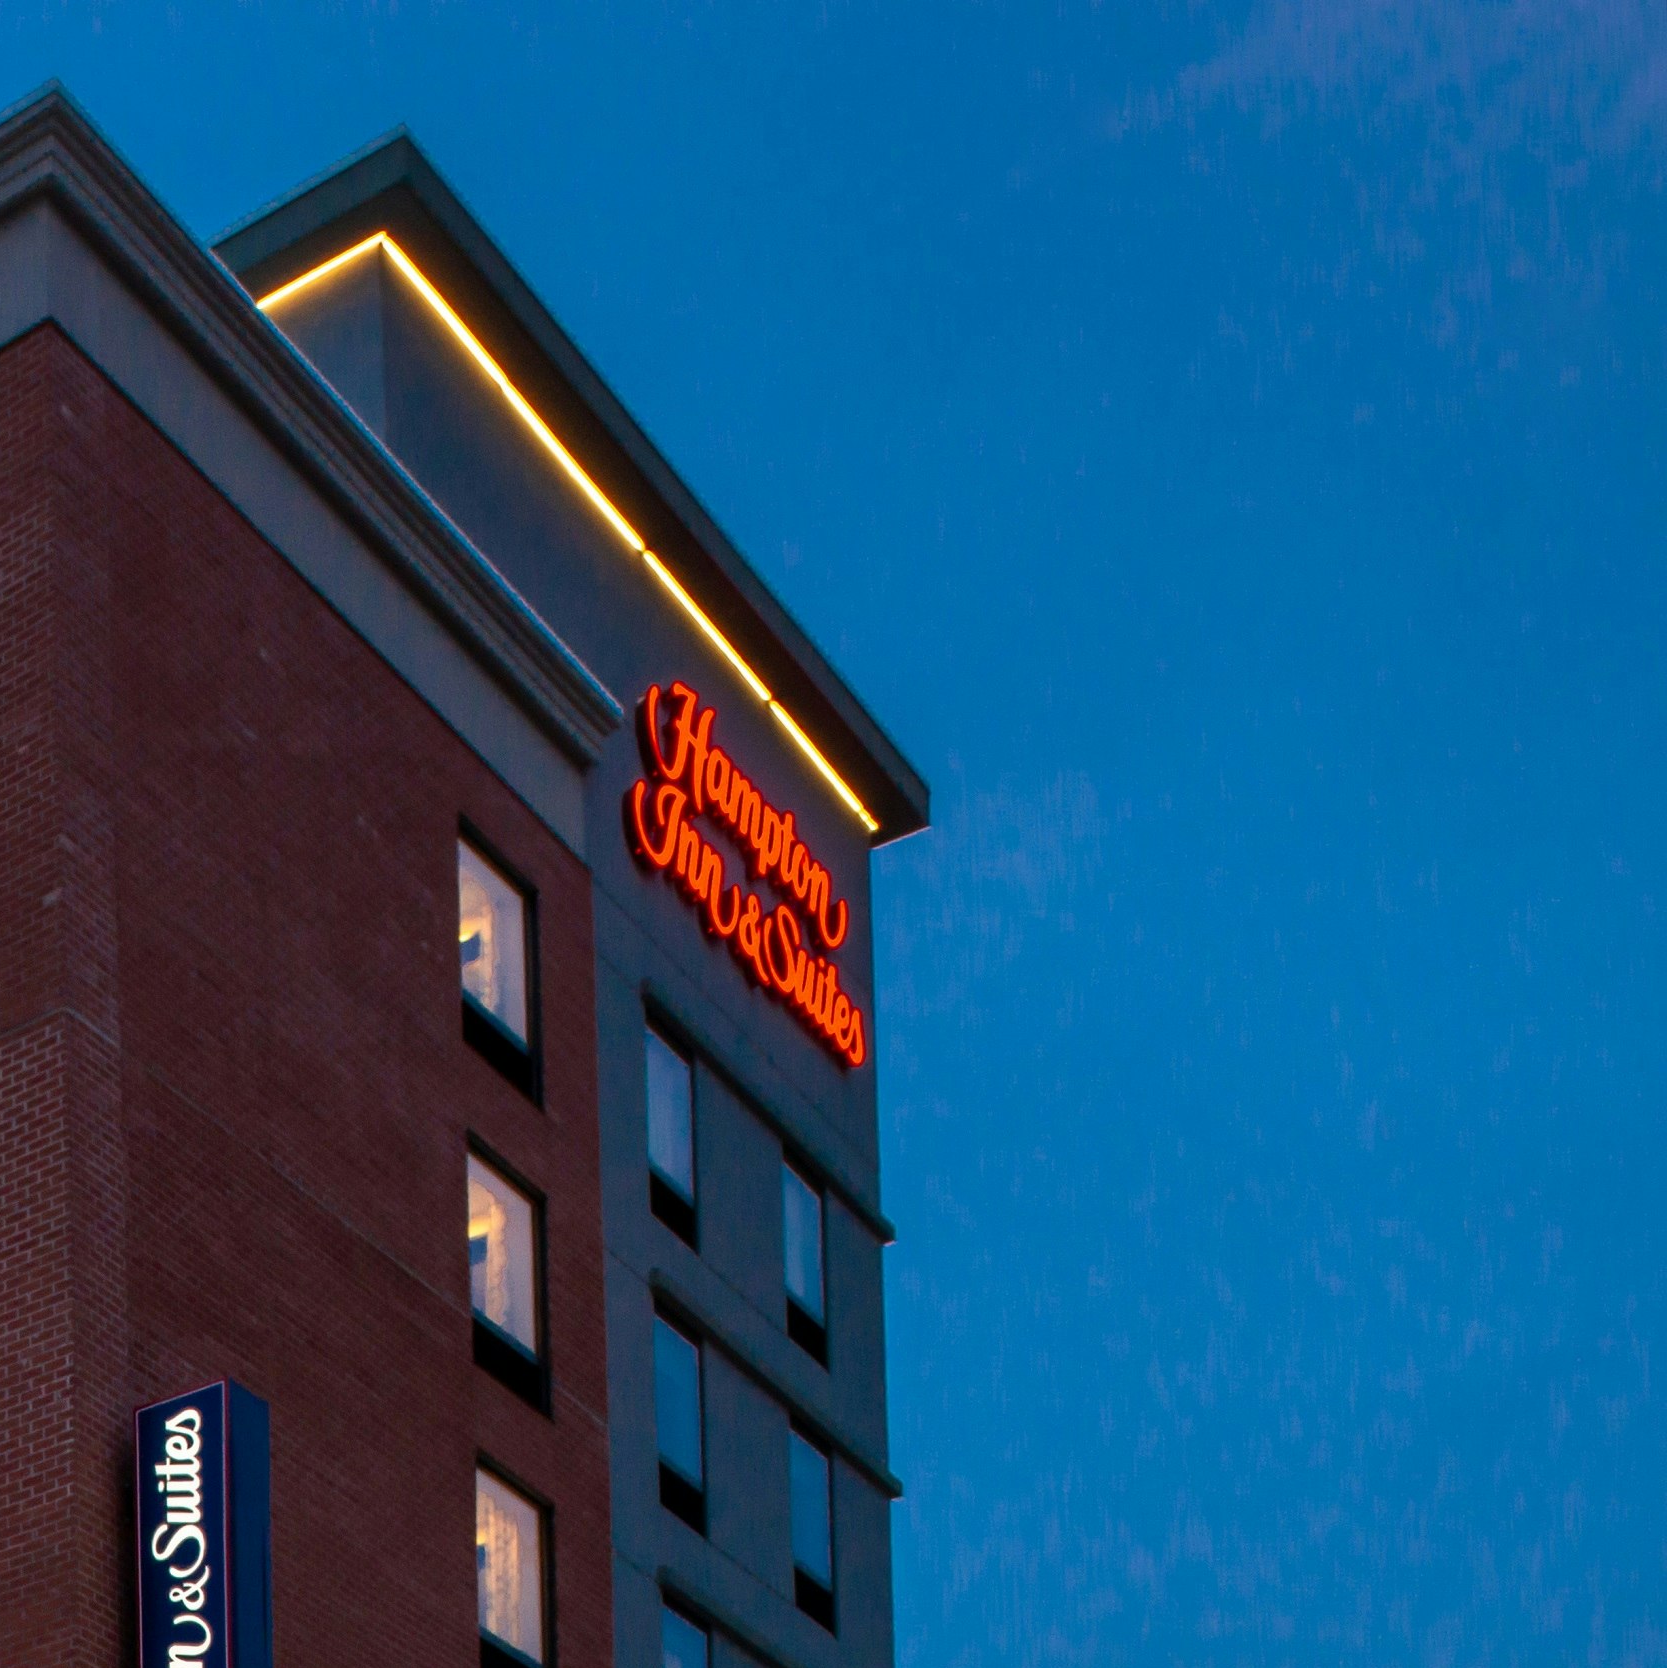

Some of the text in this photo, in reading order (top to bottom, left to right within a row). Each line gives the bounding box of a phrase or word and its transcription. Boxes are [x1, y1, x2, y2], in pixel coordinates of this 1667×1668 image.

[634, 779, 866, 1067] Inn & Suites
[647, 681, 849, 948] Hampton
[151, 1408, 206, 1578] Suites
[168, 1565, 210, 1611] &
